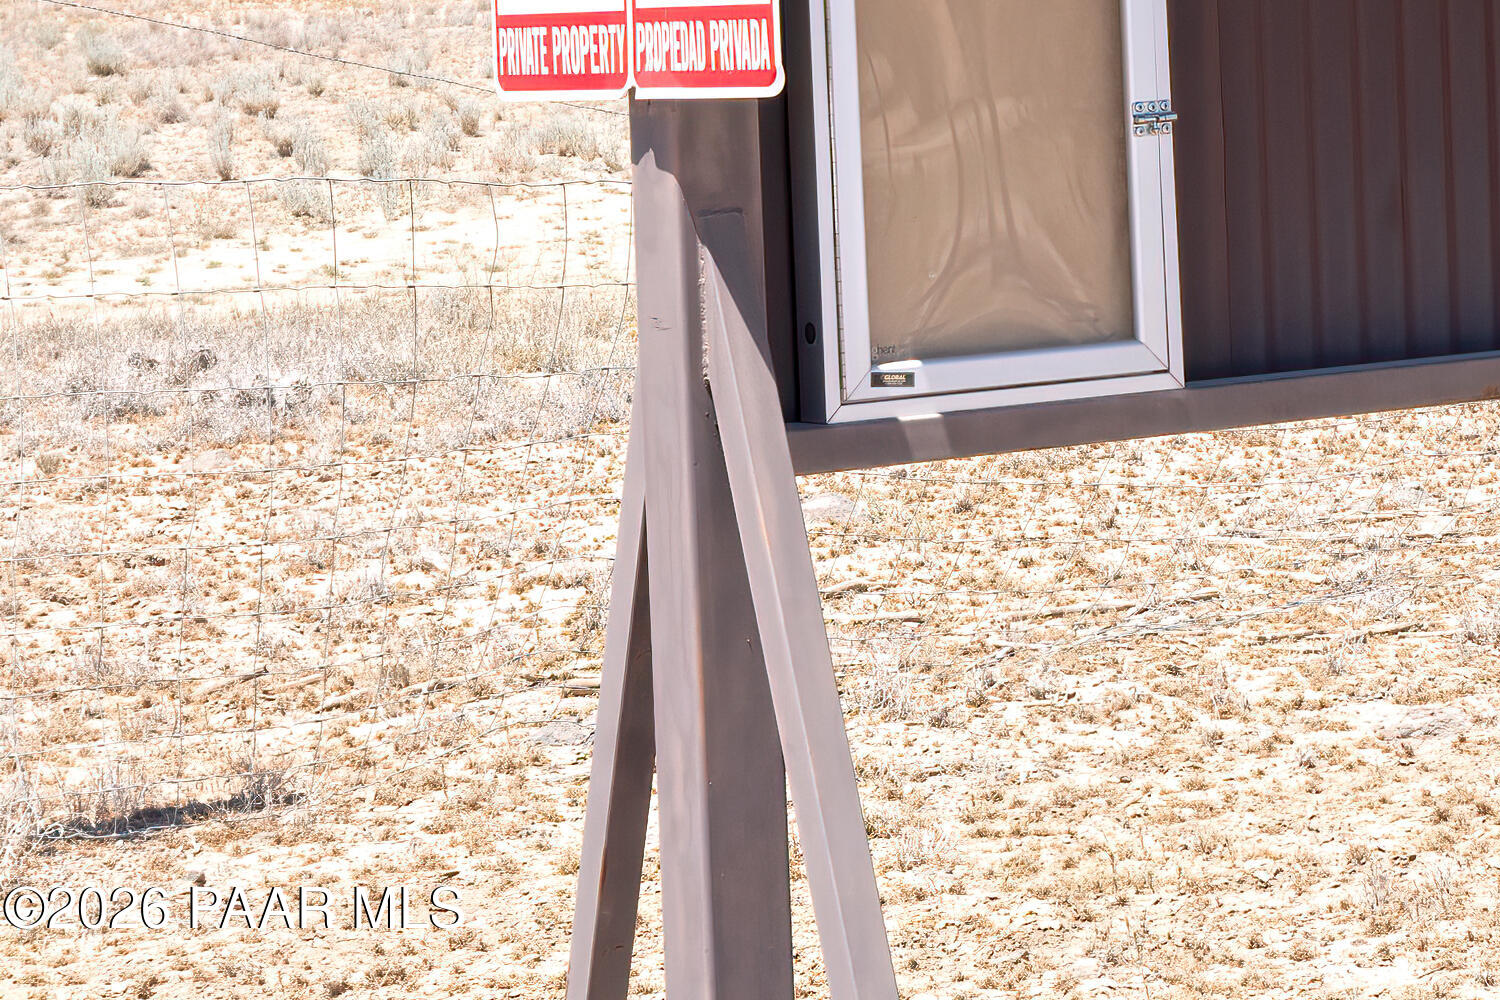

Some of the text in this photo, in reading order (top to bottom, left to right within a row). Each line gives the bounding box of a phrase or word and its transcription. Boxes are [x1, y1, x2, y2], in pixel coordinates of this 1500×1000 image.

[498, 23, 626, 76] PRIVATE PROPERTY
[635, 18, 772, 73] PROPIEDAD PRIVADA
